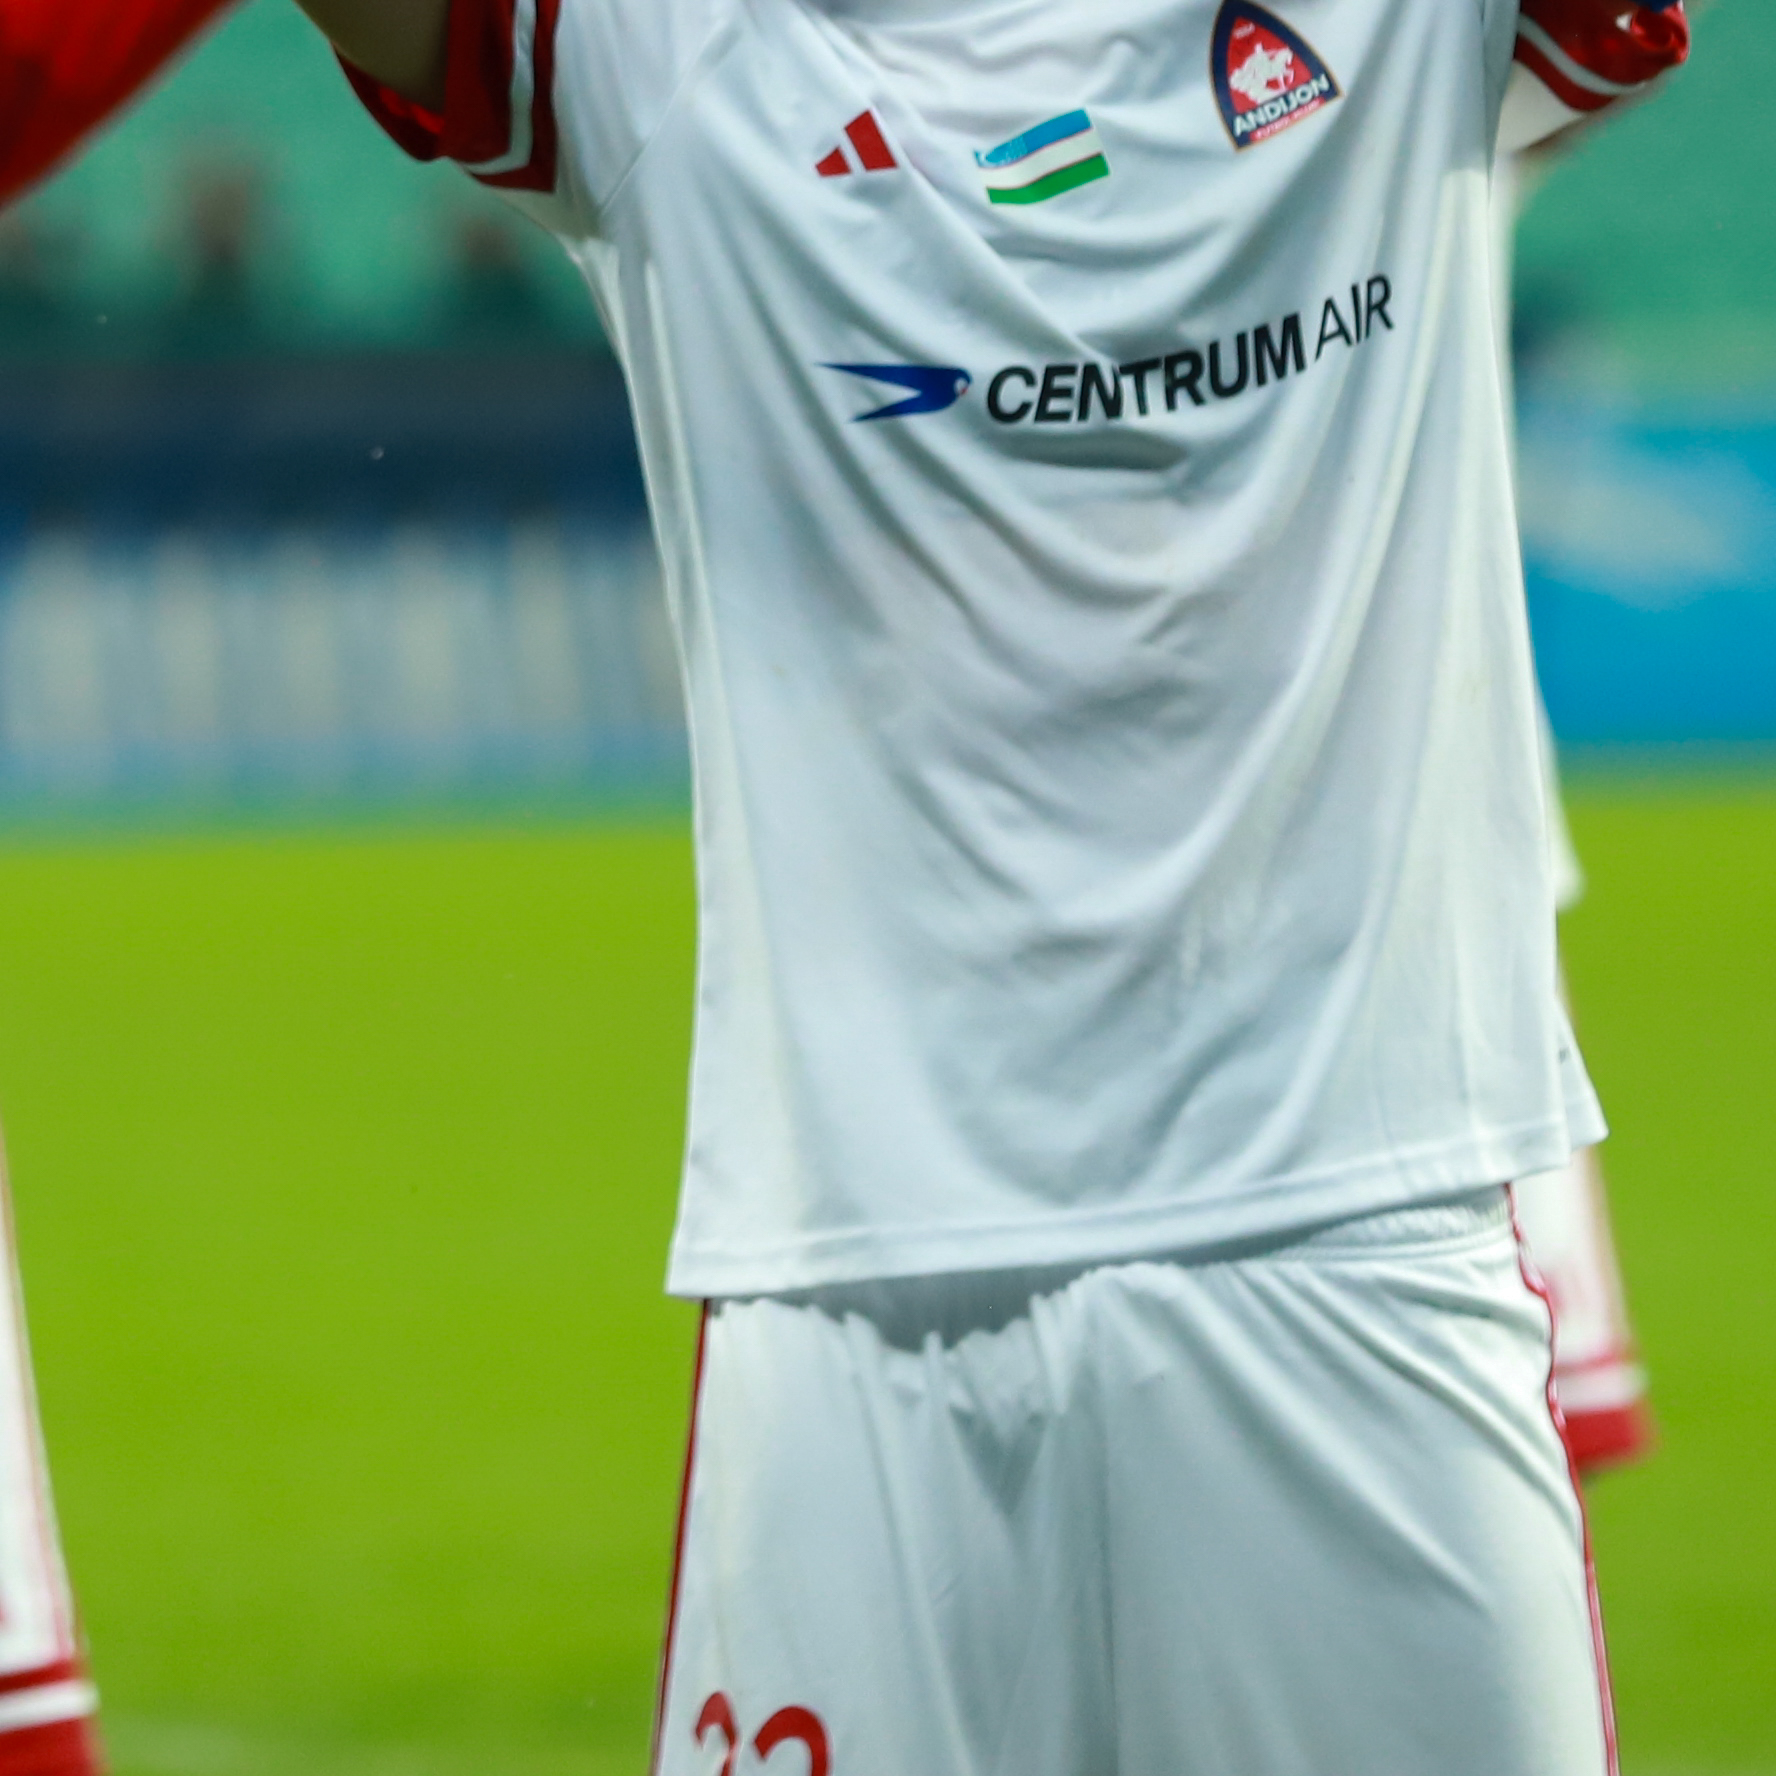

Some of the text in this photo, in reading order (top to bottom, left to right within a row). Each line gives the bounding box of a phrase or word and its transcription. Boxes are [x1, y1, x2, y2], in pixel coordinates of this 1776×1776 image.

[1233, 73, 1331, 138] ANDIJON
[985, 273, 1395, 425] CENTRUM AIR
